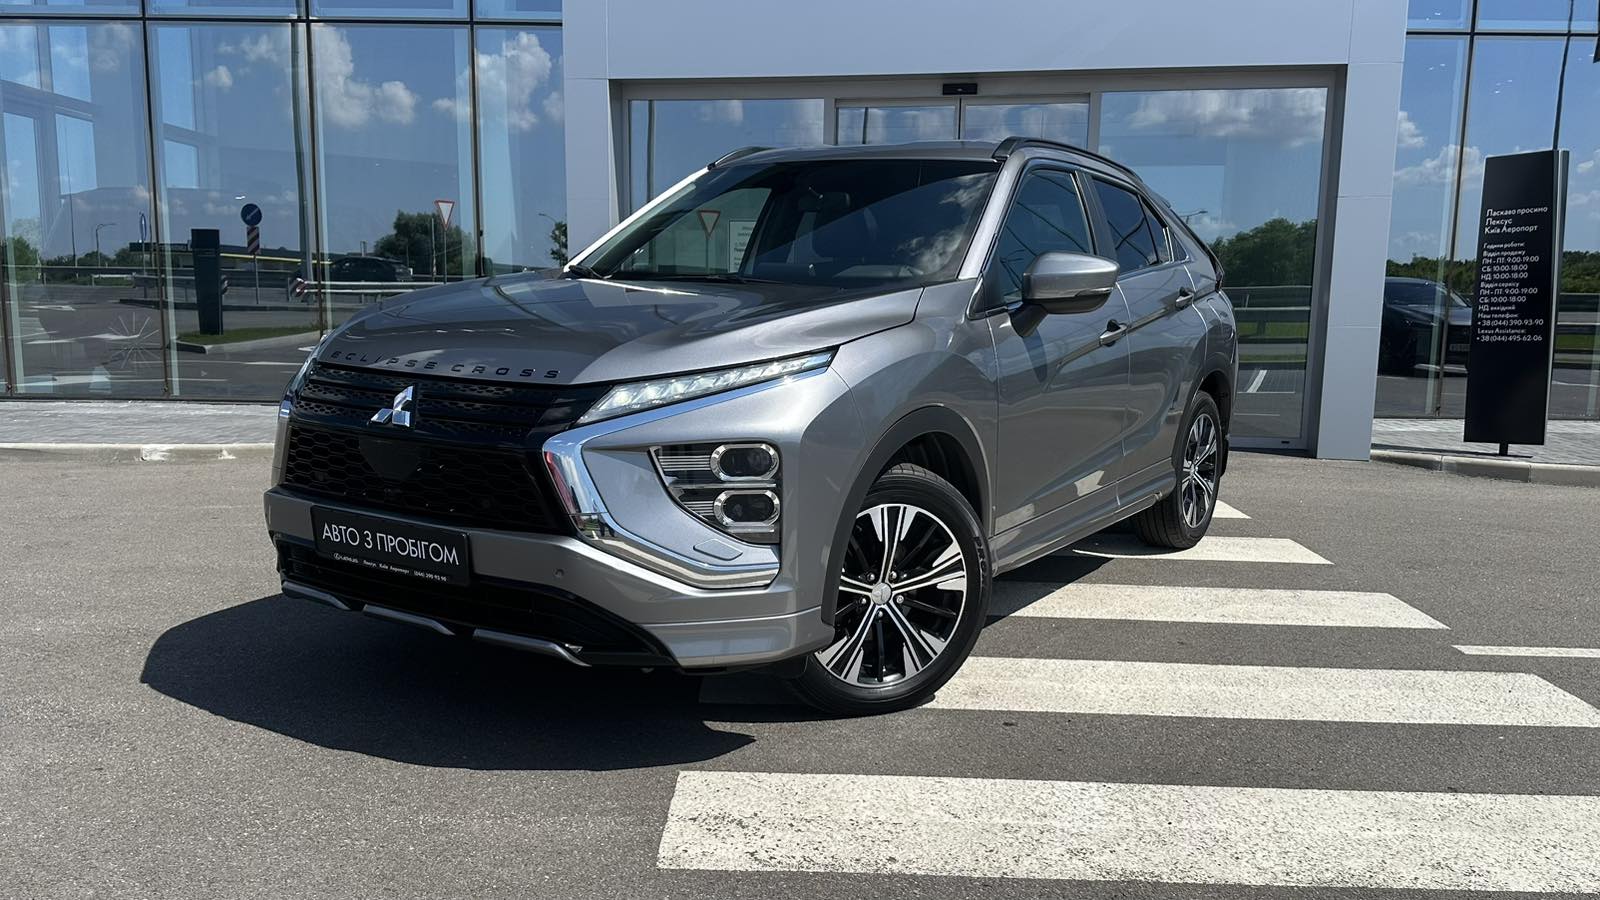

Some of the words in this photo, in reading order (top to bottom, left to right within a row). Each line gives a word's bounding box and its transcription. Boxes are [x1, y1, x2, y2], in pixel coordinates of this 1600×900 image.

[1517, 207, 1548, 215] просимо
[1501, 225, 1538, 234] Аеропорт
[331, 351, 438, 370] ECLIPSE
[451, 364, 561, 379] CROSS
[322, 522, 360, 546] АВТО
[376, 532, 460, 566] ПРОБІГОМ
